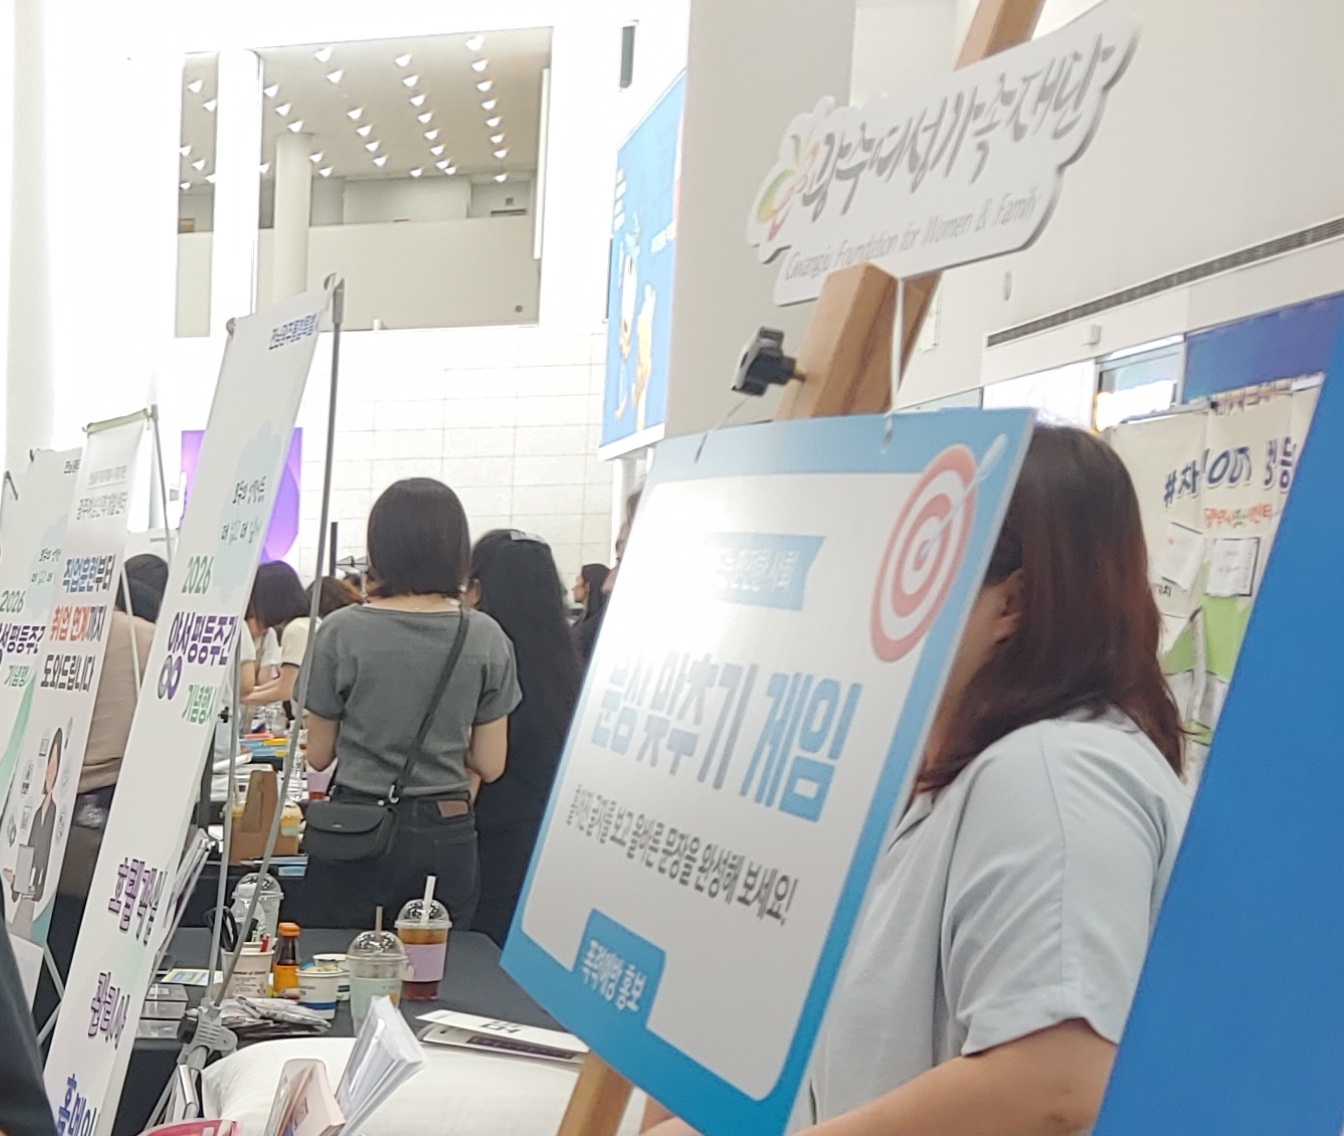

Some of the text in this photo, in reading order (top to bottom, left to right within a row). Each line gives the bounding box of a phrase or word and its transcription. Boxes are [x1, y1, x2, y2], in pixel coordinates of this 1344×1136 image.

[801, 33, 1116, 223] 광주여성가족재단
[923, 211, 974, 243] Women
[994, 187, 1042, 229] Family
[63, 553, 116, 593] 직업훈련부터
[181, 555, 214, 595] 2026
[49, 604, 70, 642] 취업
[40, 654, 95, 692] 도와드립니다
[635, 650, 759, 790] 맞추기
[740, 670, 863, 823] 게임
[610, 806, 634, 847] 보고
[626, 814, 665, 868] 올바른
[658, 828, 701, 886] 문장을
[694, 844, 746, 905] 완성해
[737, 861, 799, 927] 보세요!
